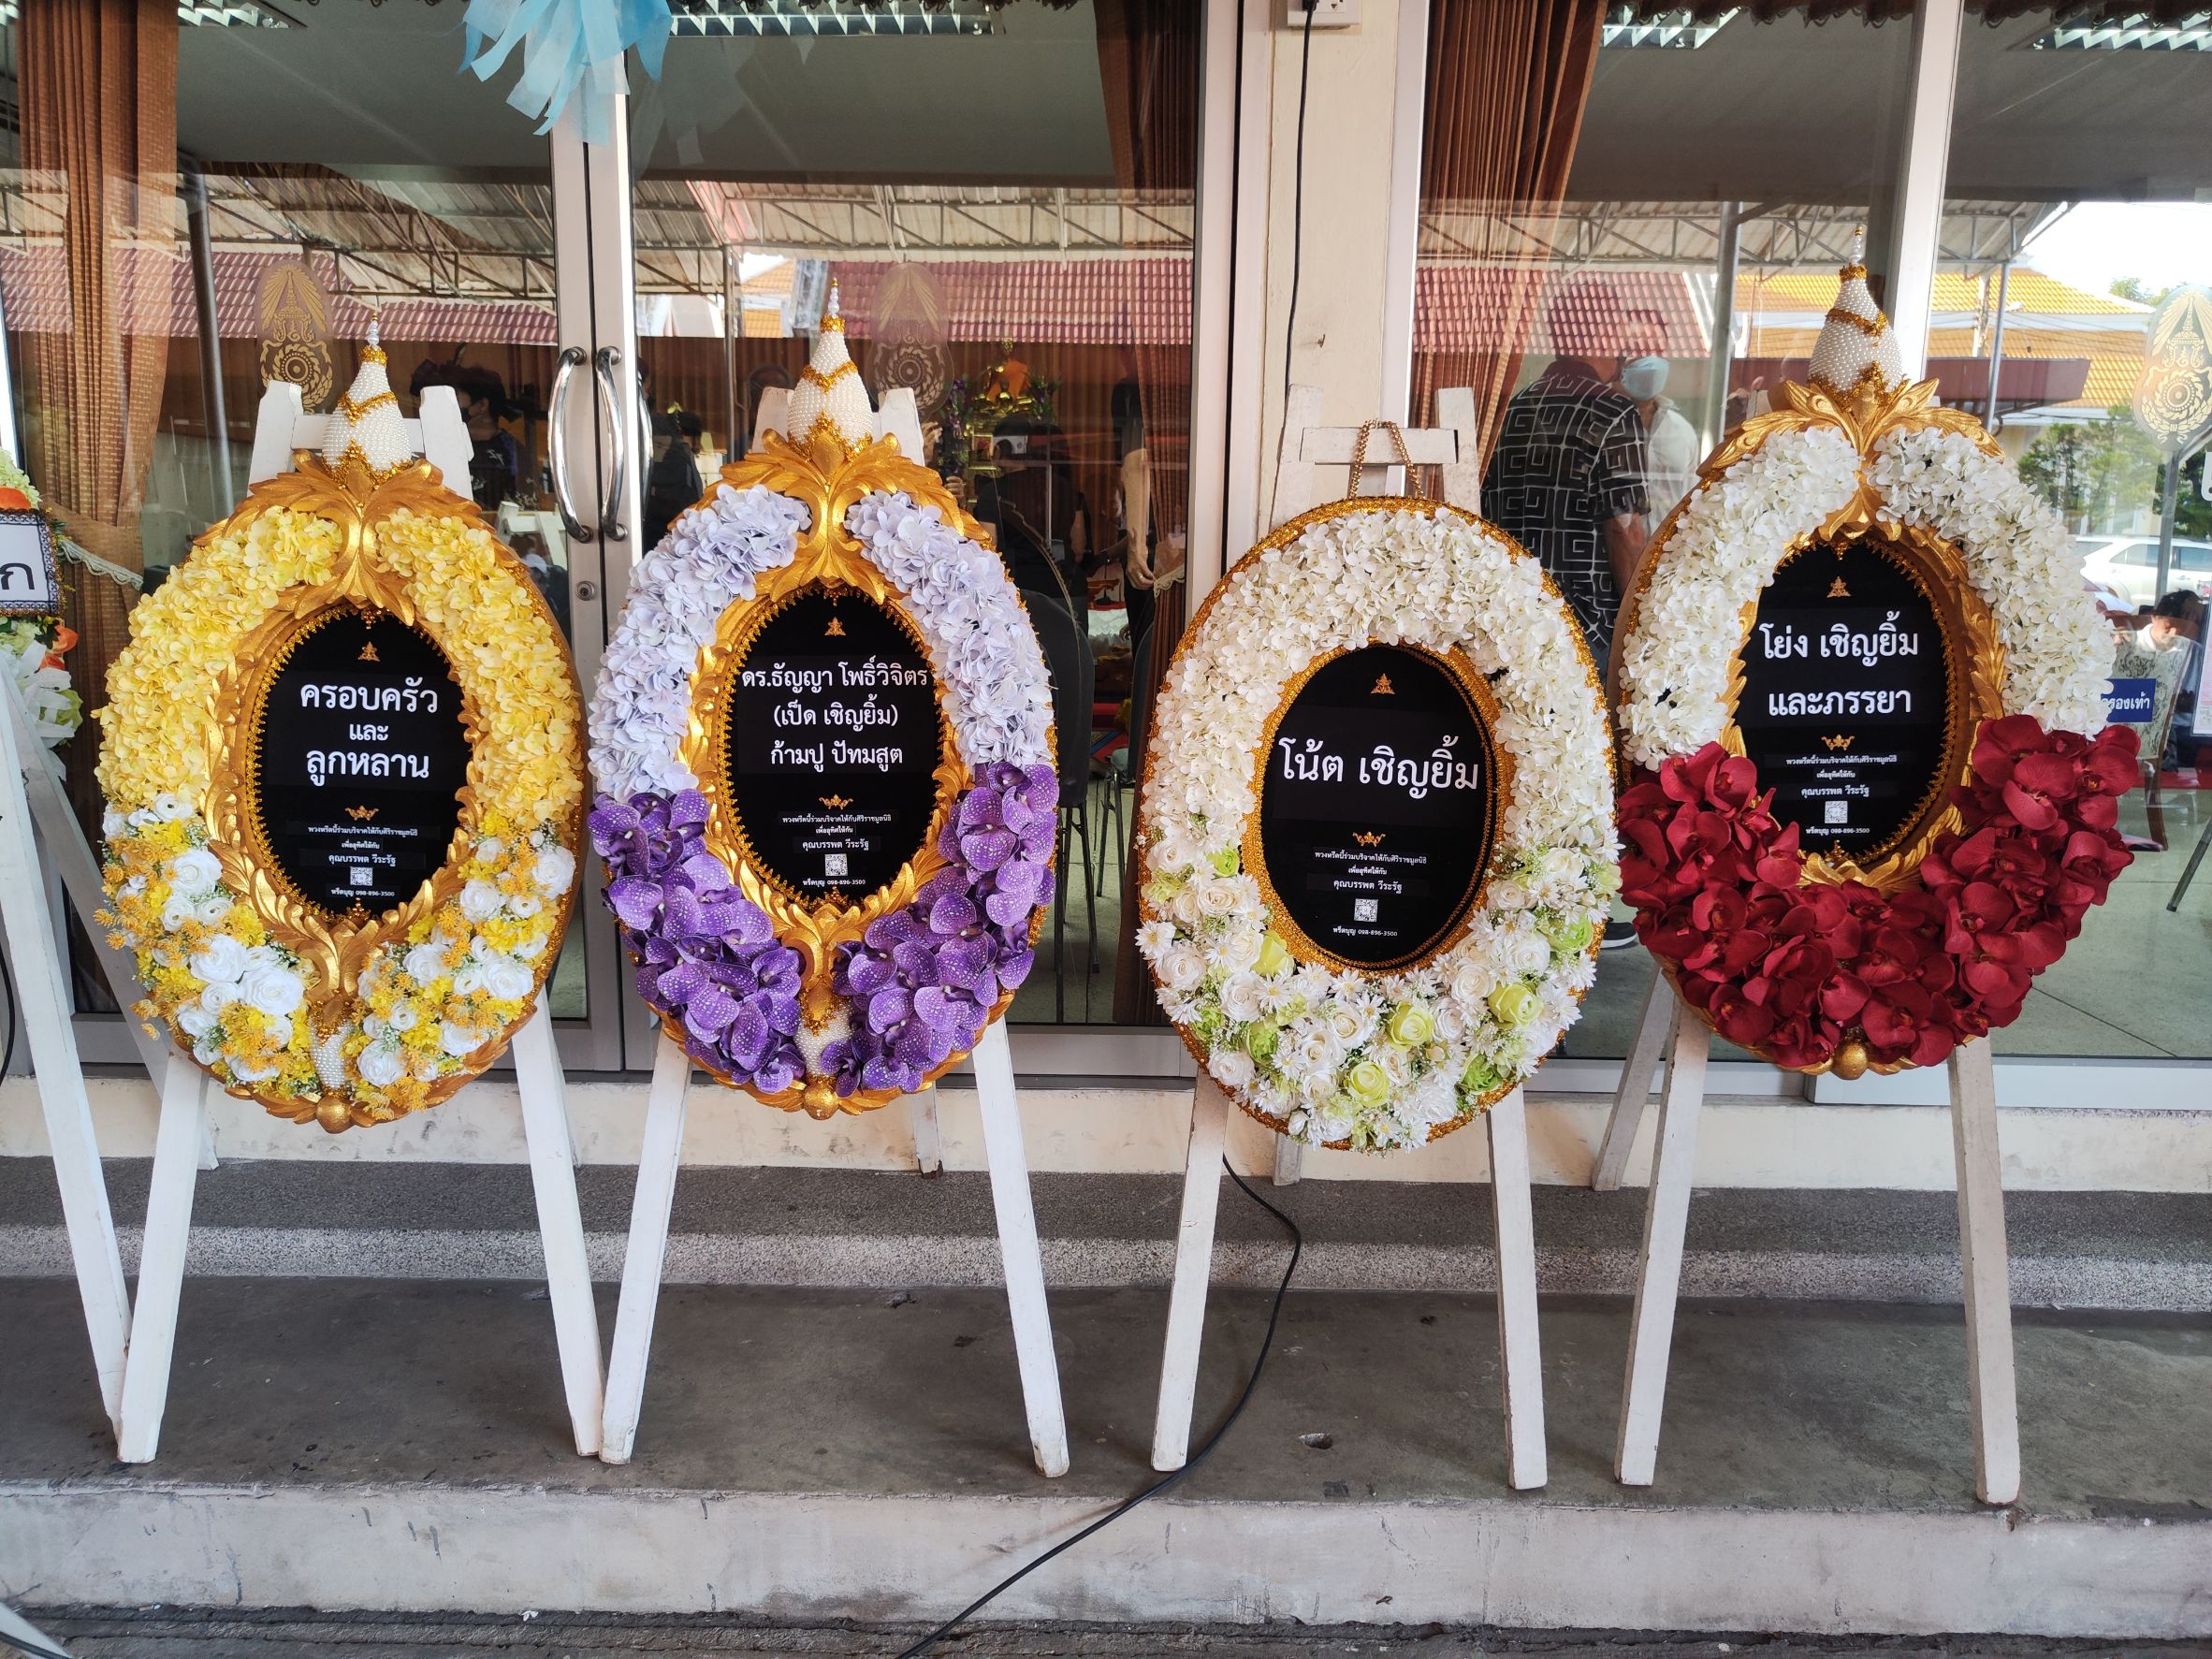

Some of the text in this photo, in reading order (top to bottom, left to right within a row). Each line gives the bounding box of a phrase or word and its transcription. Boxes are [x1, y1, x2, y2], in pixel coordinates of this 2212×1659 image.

[1759, 611, 1917, 666] โย่ง เชิญยิ้ม
[742, 655, 927, 693] ดร.ธัญญา โพธิ์วิจิตร
[301, 677, 437, 713] ครอบครัว
[774, 693, 897, 732] (เป็ด เชิญยิ้ม)
[1769, 691, 1911, 716] และภรรยา
[349, 723, 389, 741] และ
[307, 750, 429, 786] ลูกหลาน
[771, 740, 902, 772] ก้ามปู ปัทมสูต
[1279, 735, 1477, 799] โน้ต เชิญยิ้ม
